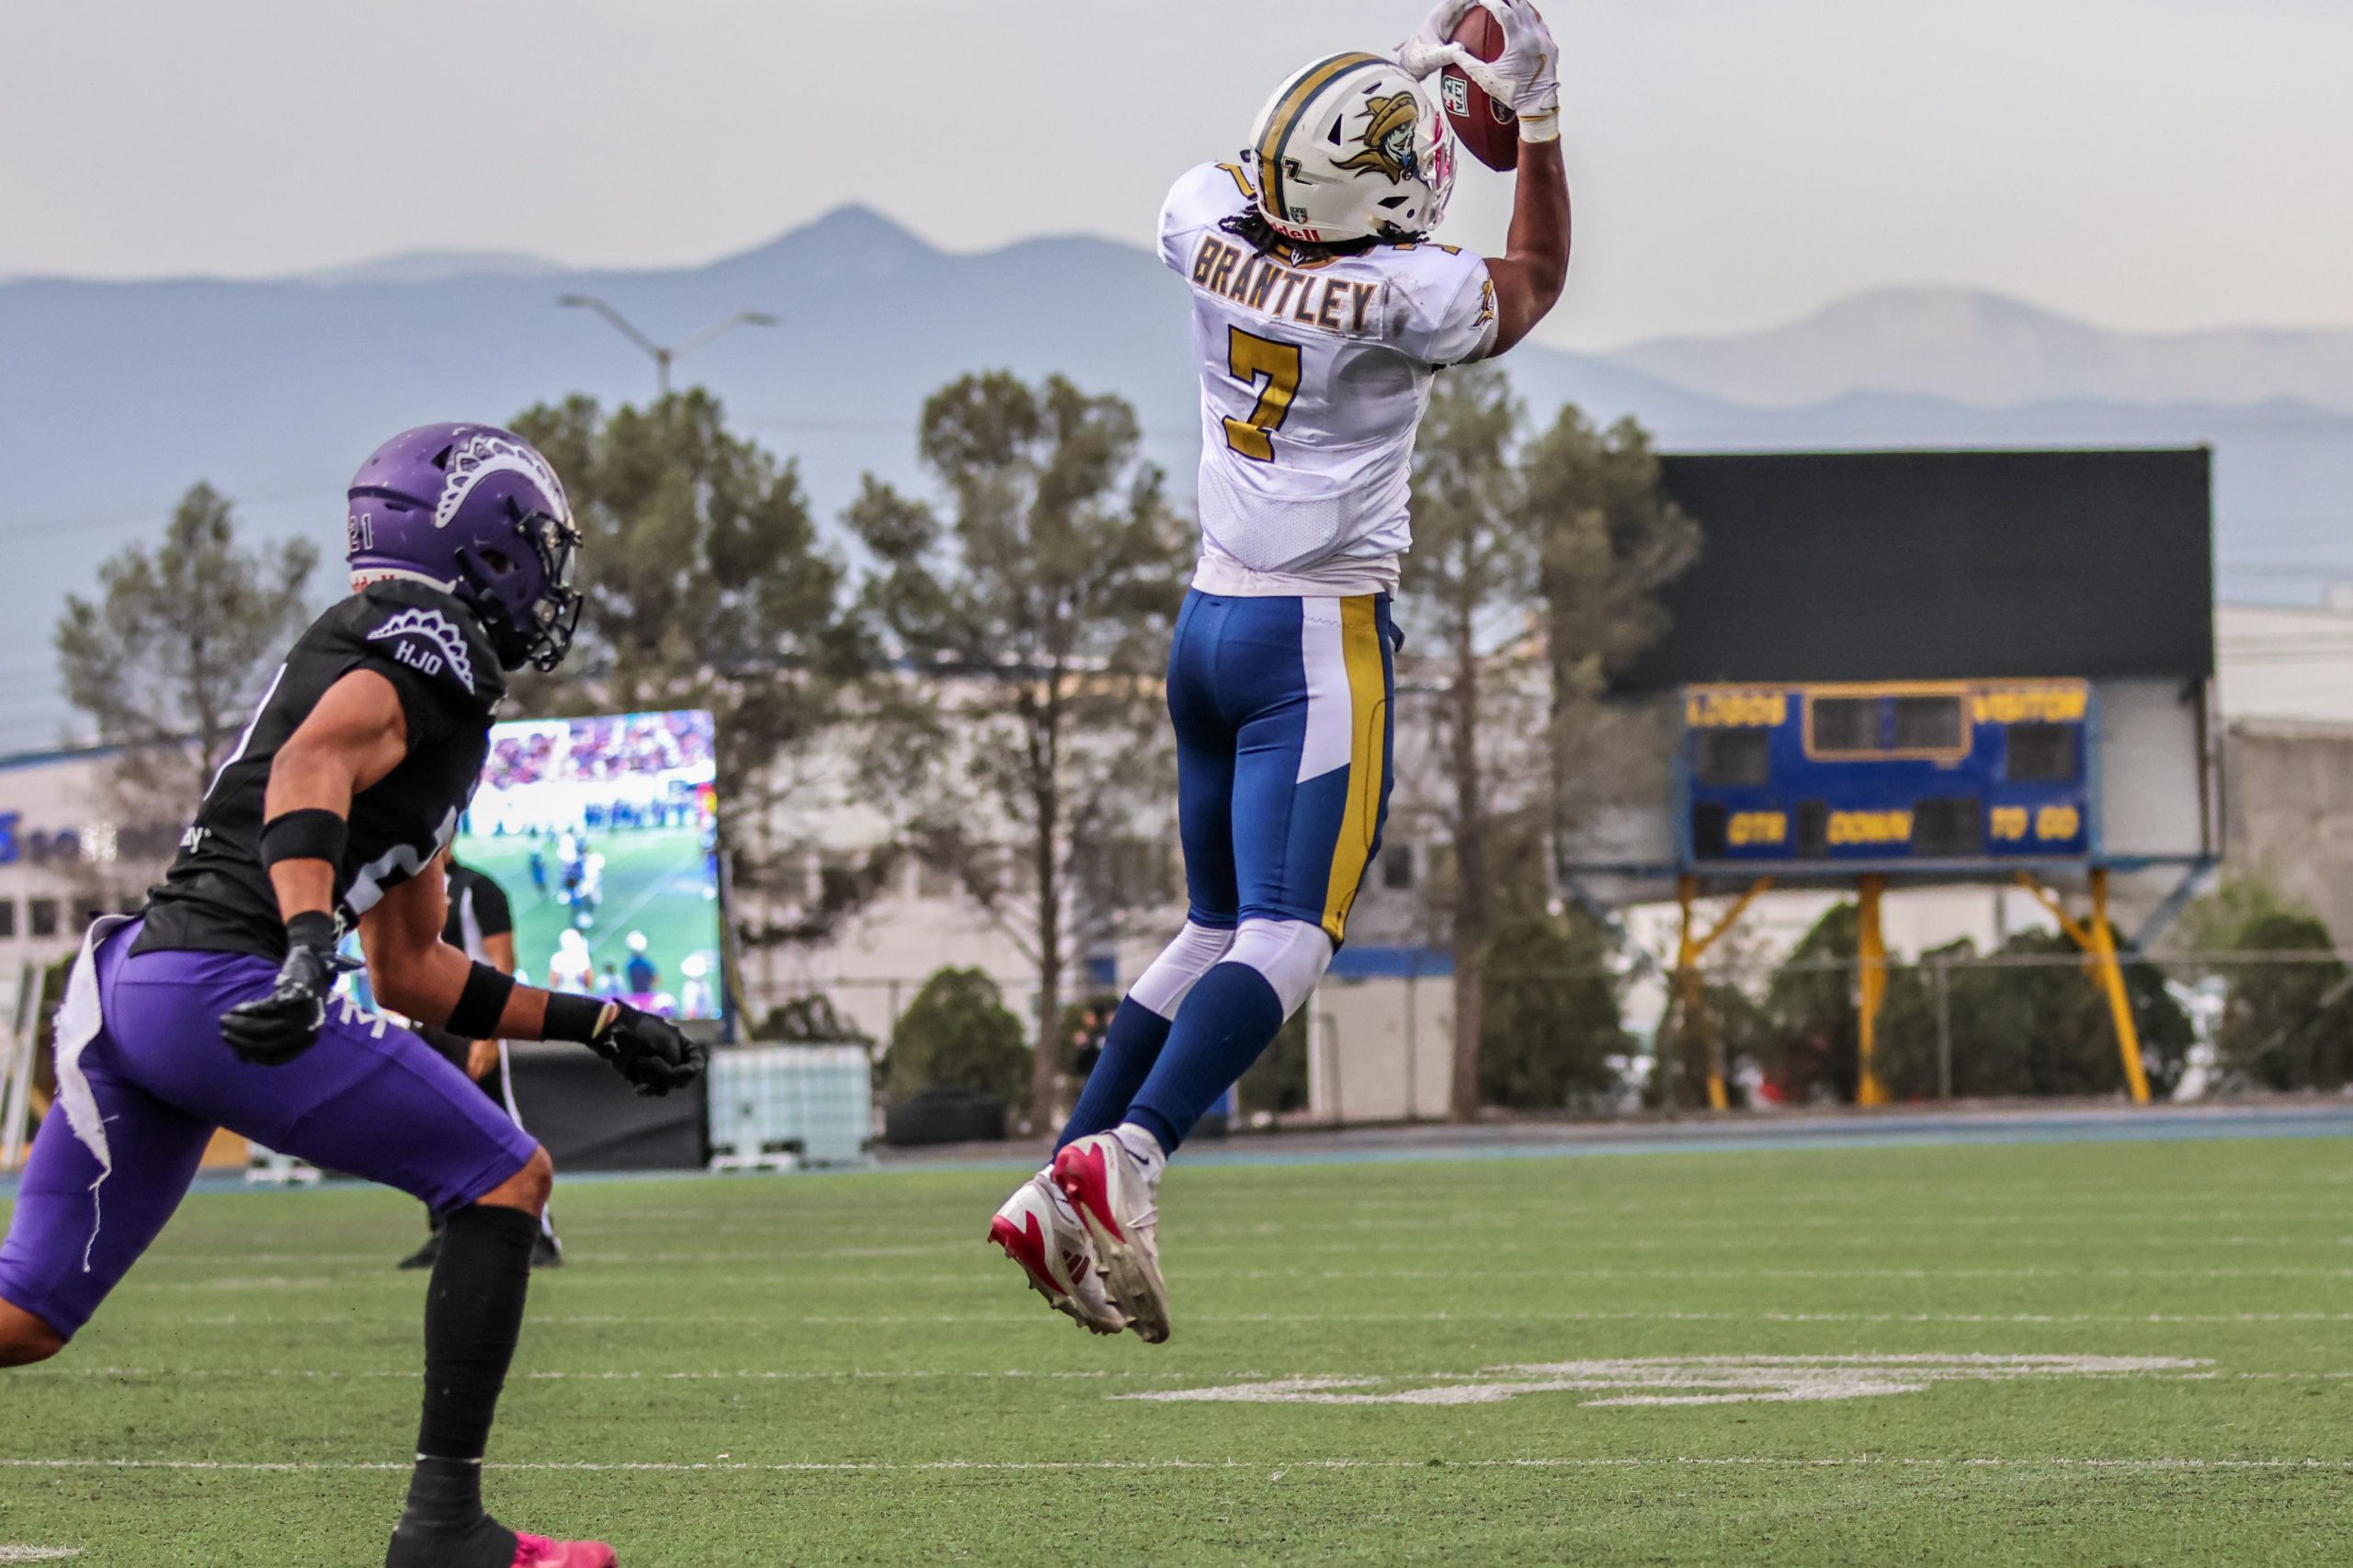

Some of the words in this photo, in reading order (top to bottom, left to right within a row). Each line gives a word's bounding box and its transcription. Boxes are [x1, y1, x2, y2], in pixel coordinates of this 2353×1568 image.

[1454, 83, 1463, 110] LFA
[1283, 157, 1302, 180] 7
[1192, 234, 1379, 335] BRANTLEY
[1222, 323, 1302, 464] 7
[1826, 810, 1914, 844] DOWN
